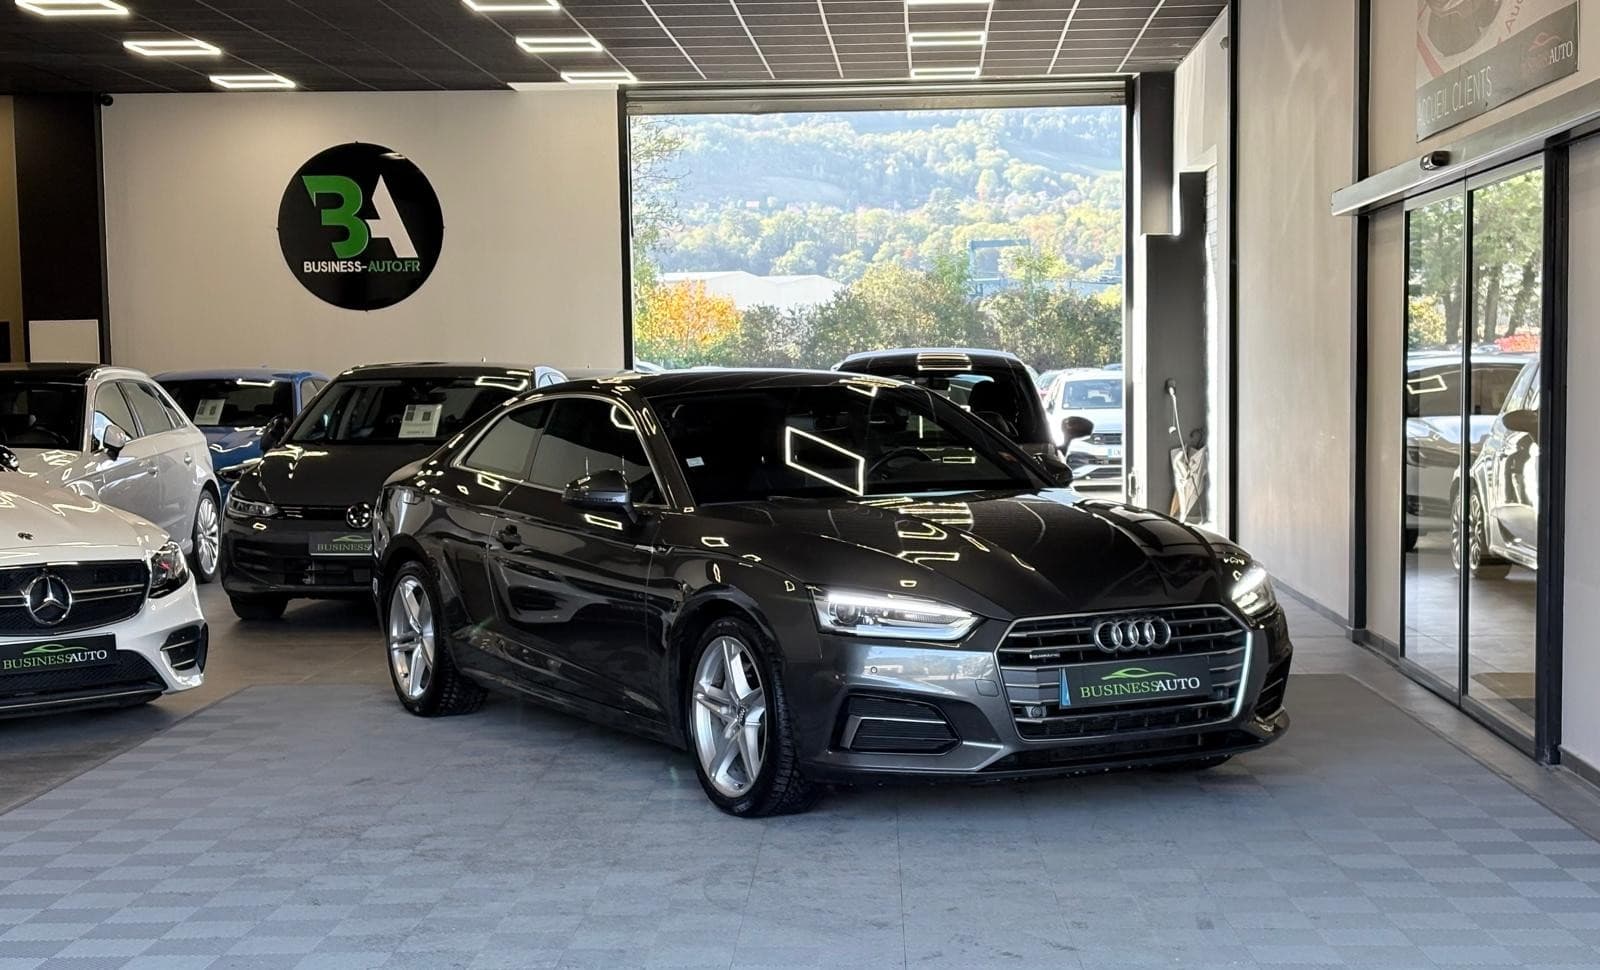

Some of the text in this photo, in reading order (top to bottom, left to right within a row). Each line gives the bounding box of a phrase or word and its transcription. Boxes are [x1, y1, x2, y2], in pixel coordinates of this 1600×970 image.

[1452, 65, 1492, 111] CLIENTS
[304, 260, 420, 273] BUSINESS-AUTO.FR
[3, 649, 107, 670] BUSINESSAUTO
[1080, 677, 1200, 699] BUSINESSAUTO
